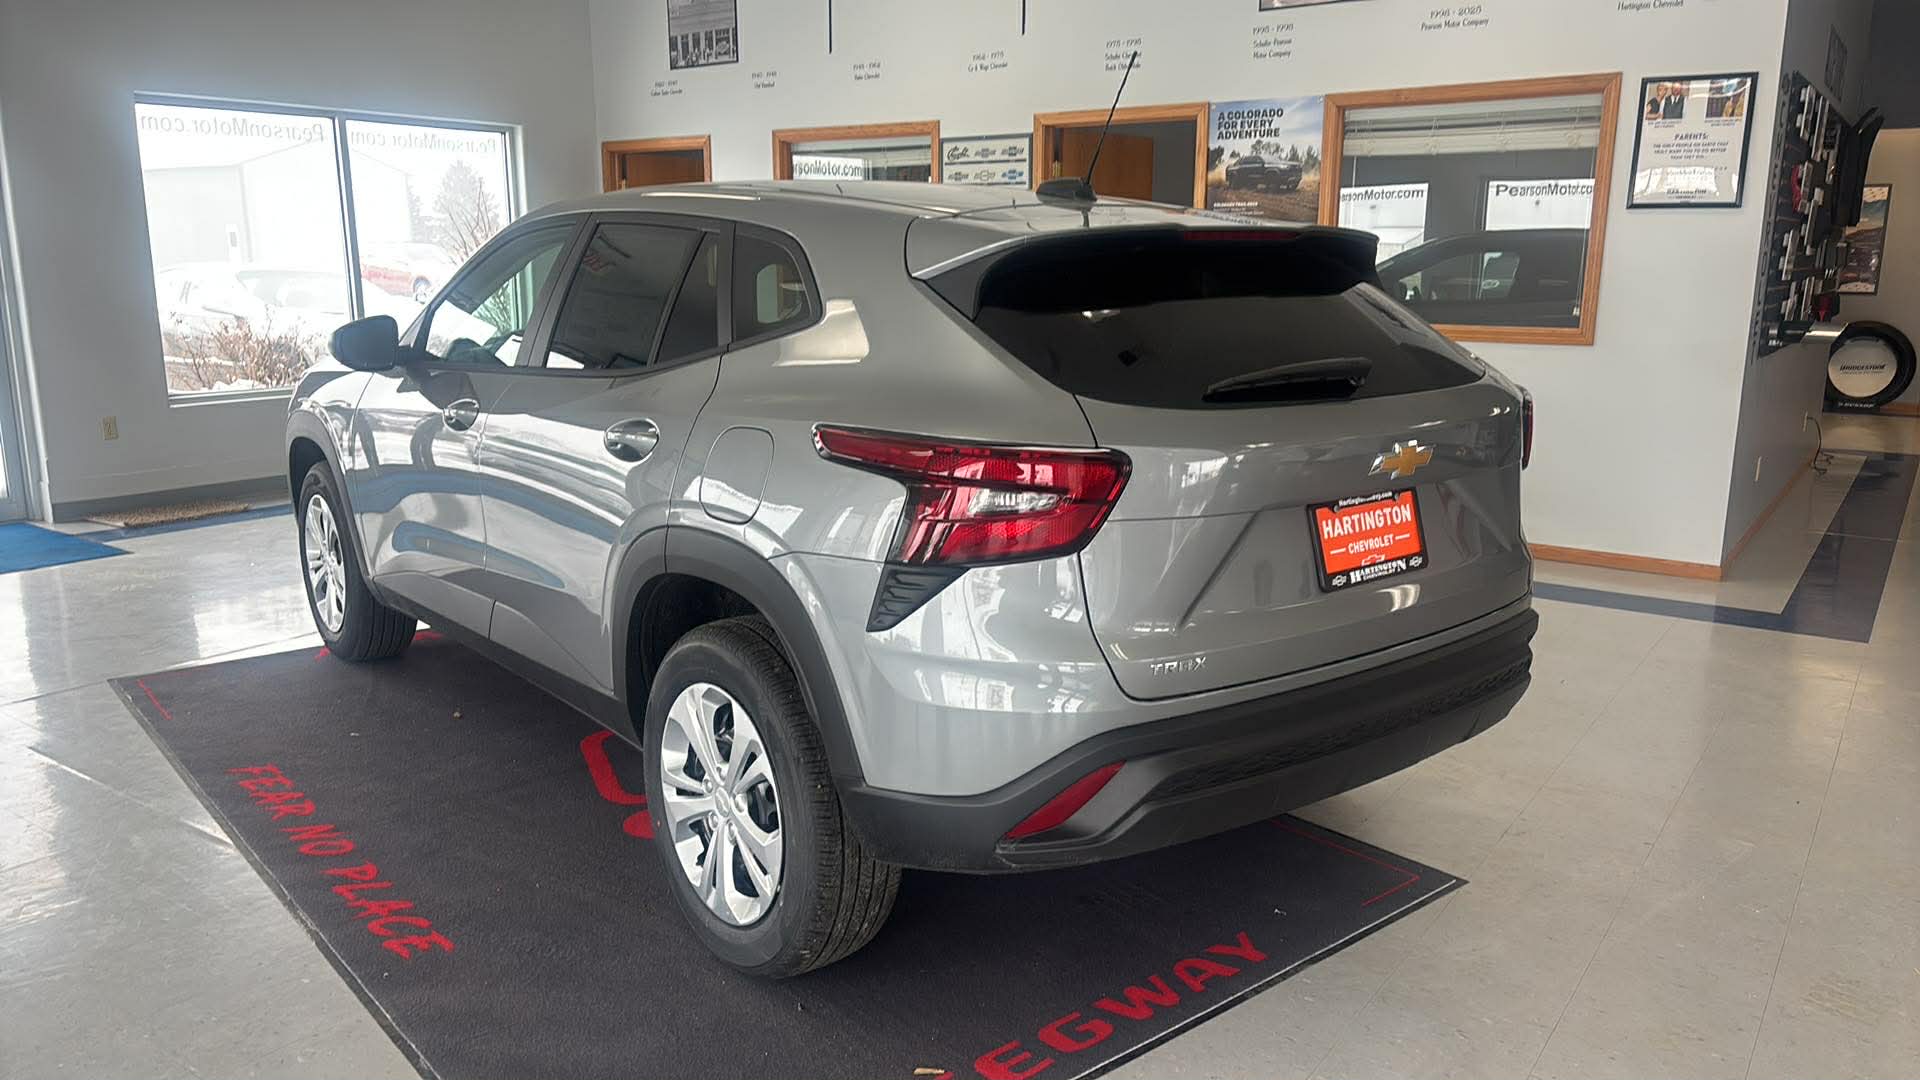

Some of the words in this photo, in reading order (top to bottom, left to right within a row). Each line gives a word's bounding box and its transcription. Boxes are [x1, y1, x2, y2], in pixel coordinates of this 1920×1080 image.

[1444, 19, 1460, 28] Motor
[1462, 18, 1489, 29] Company
[1217, 111, 1226, 121] A
[1227, 107, 1284, 120] COLORADO
[1217, 120, 1238, 131] FOR
[1240, 119, 1274, 130] EVERY
[1217, 127, 1281, 140] ADVENTURE
[1322, 503, 1412, 540] HARTINGTON
[1348, 533, 1395, 555] CHEVROLET
[1350, 558, 1407, 584] HARTINGTON
[224, 763, 317, 822] FEAR
[277, 823, 356, 857] NO
[318, 861, 456, 961] PLACE
